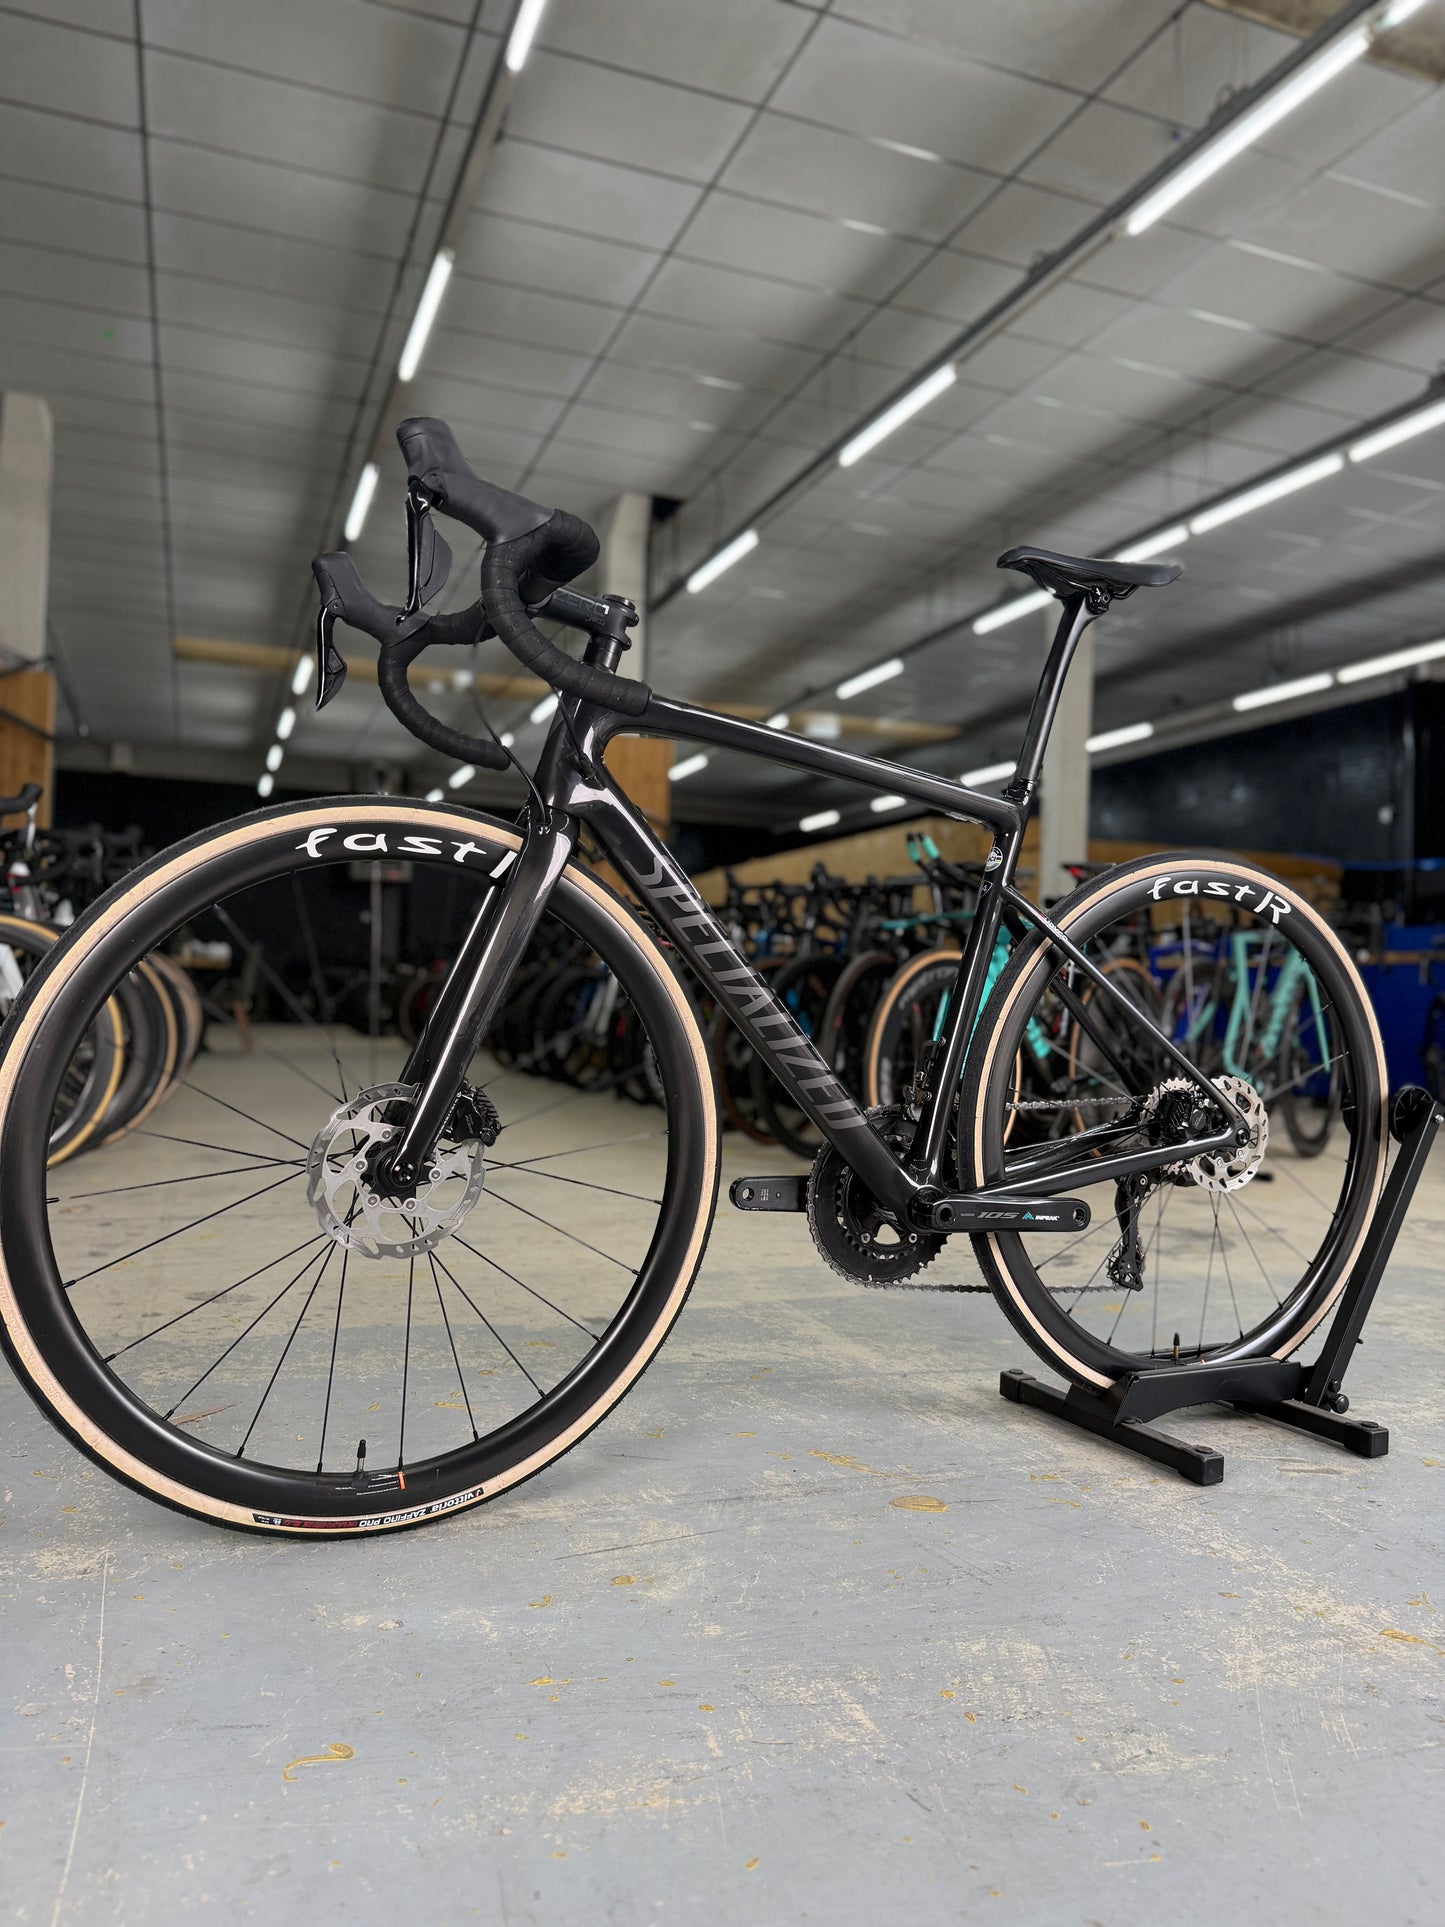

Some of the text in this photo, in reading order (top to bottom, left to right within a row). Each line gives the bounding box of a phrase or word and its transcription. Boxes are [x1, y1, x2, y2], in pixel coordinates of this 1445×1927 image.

[295, 828, 487, 863] fast
[1147, 877, 1292, 925] fast R
[625, 855, 869, 1130] SPECIALIZED
[977, 1211, 1020, 1219] 105
[431, 1492, 475, 1513] vittoria
[358, 1518, 381, 1528] PRO
[383, 1508, 427, 1524] ZAFFIRO
